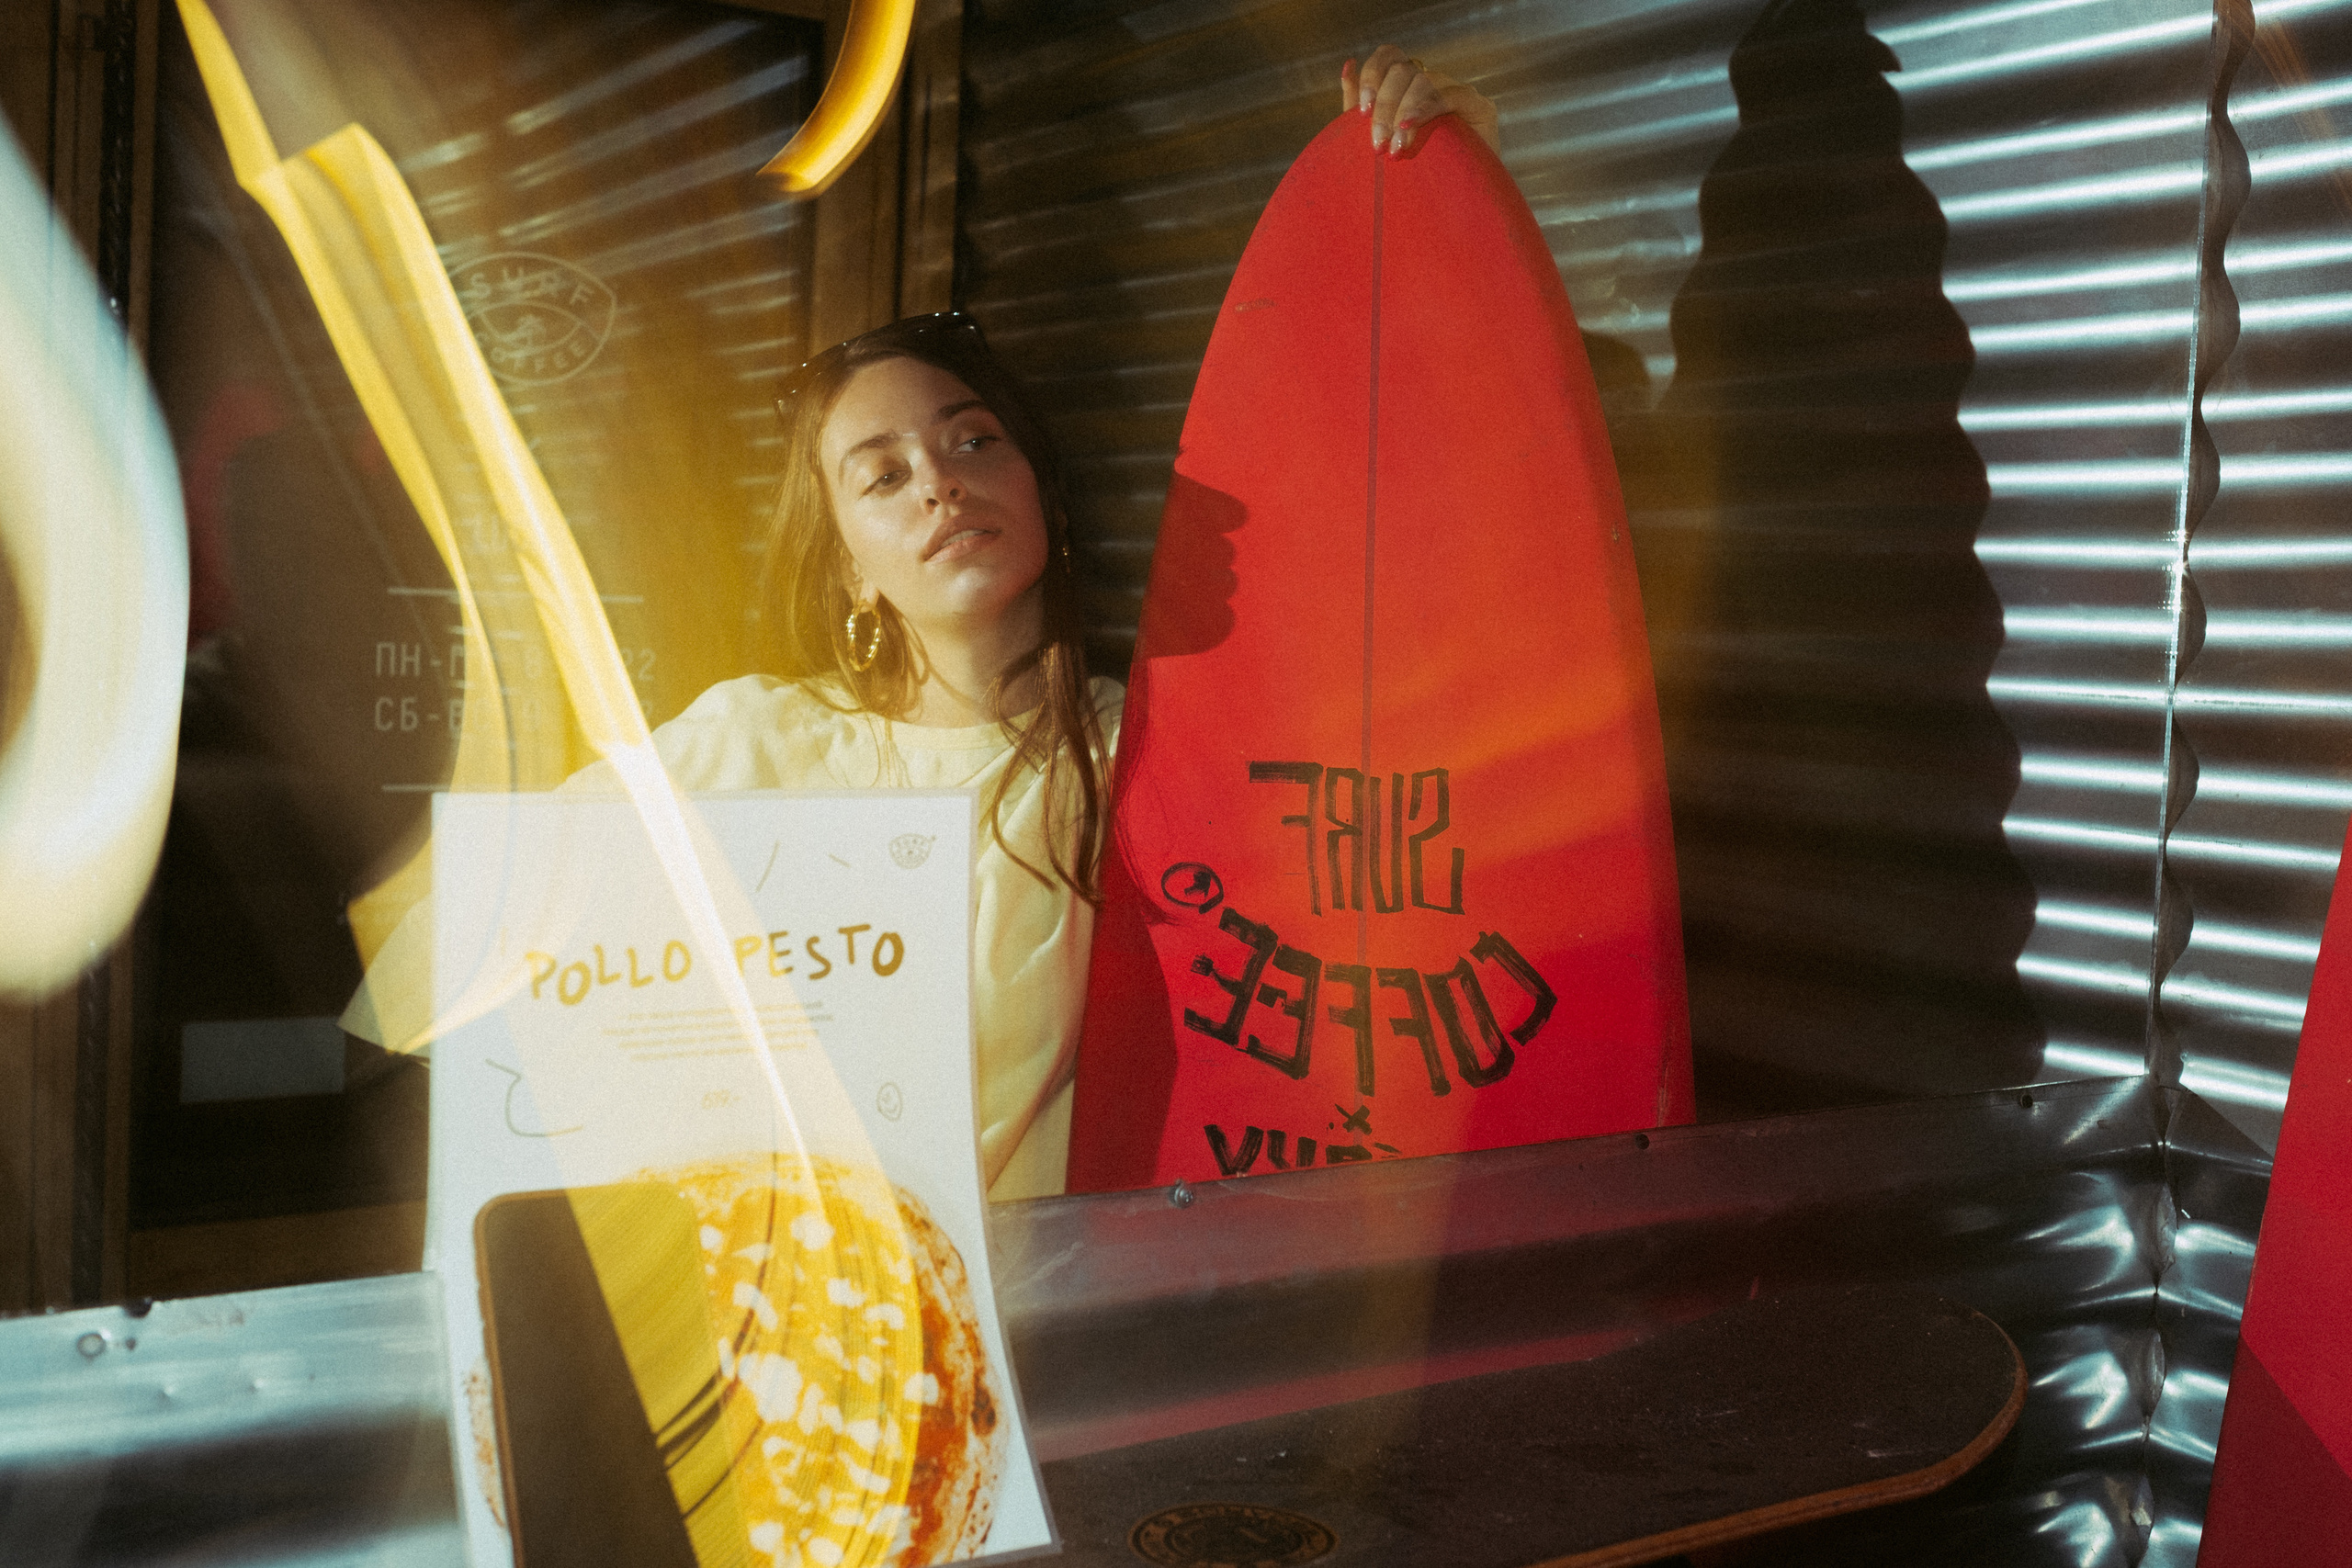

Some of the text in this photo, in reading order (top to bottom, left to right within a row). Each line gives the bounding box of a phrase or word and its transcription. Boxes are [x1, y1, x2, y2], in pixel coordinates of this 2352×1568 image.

[469, 265, 595, 305] SURF
[475, 332, 587, 374] COFFEE
[374, 641, 490, 681] ПН-П
[525, 924, 905, 1006] POLLO PESTO
